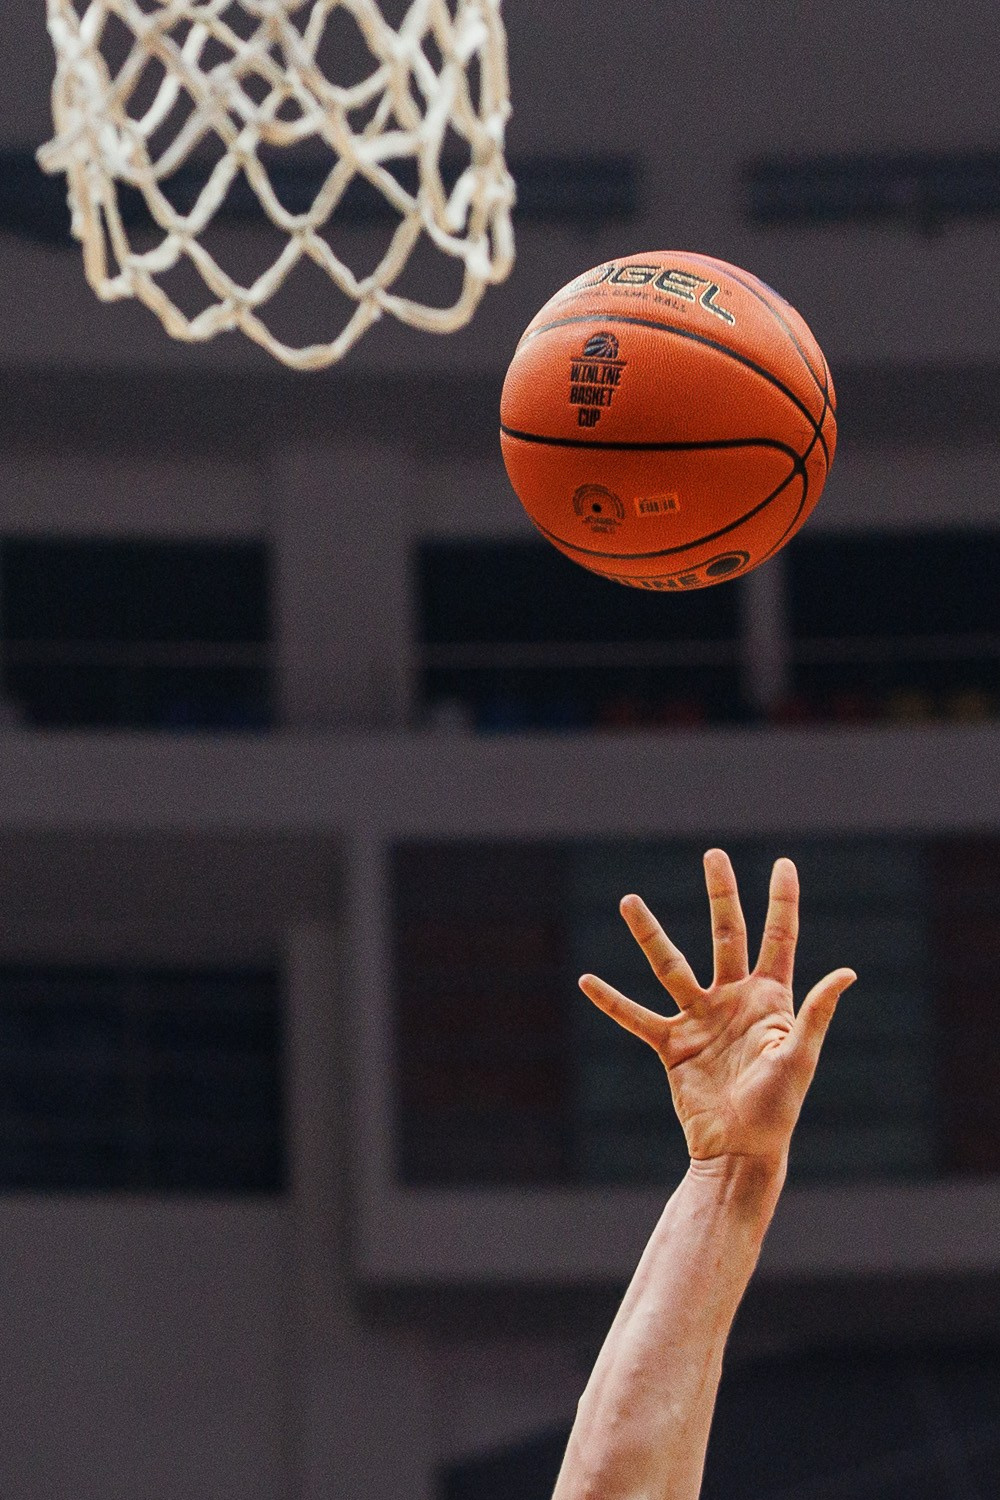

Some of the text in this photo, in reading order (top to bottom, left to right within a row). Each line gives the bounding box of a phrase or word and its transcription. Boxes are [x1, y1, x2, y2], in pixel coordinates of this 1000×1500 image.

[572, 264, 736, 326] OGEL
[654, 295, 687, 313] BALL
[571, 365, 622, 386] WINLINE
[570, 386, 614, 407] BASKET
[578, 408, 601, 428] CUP
